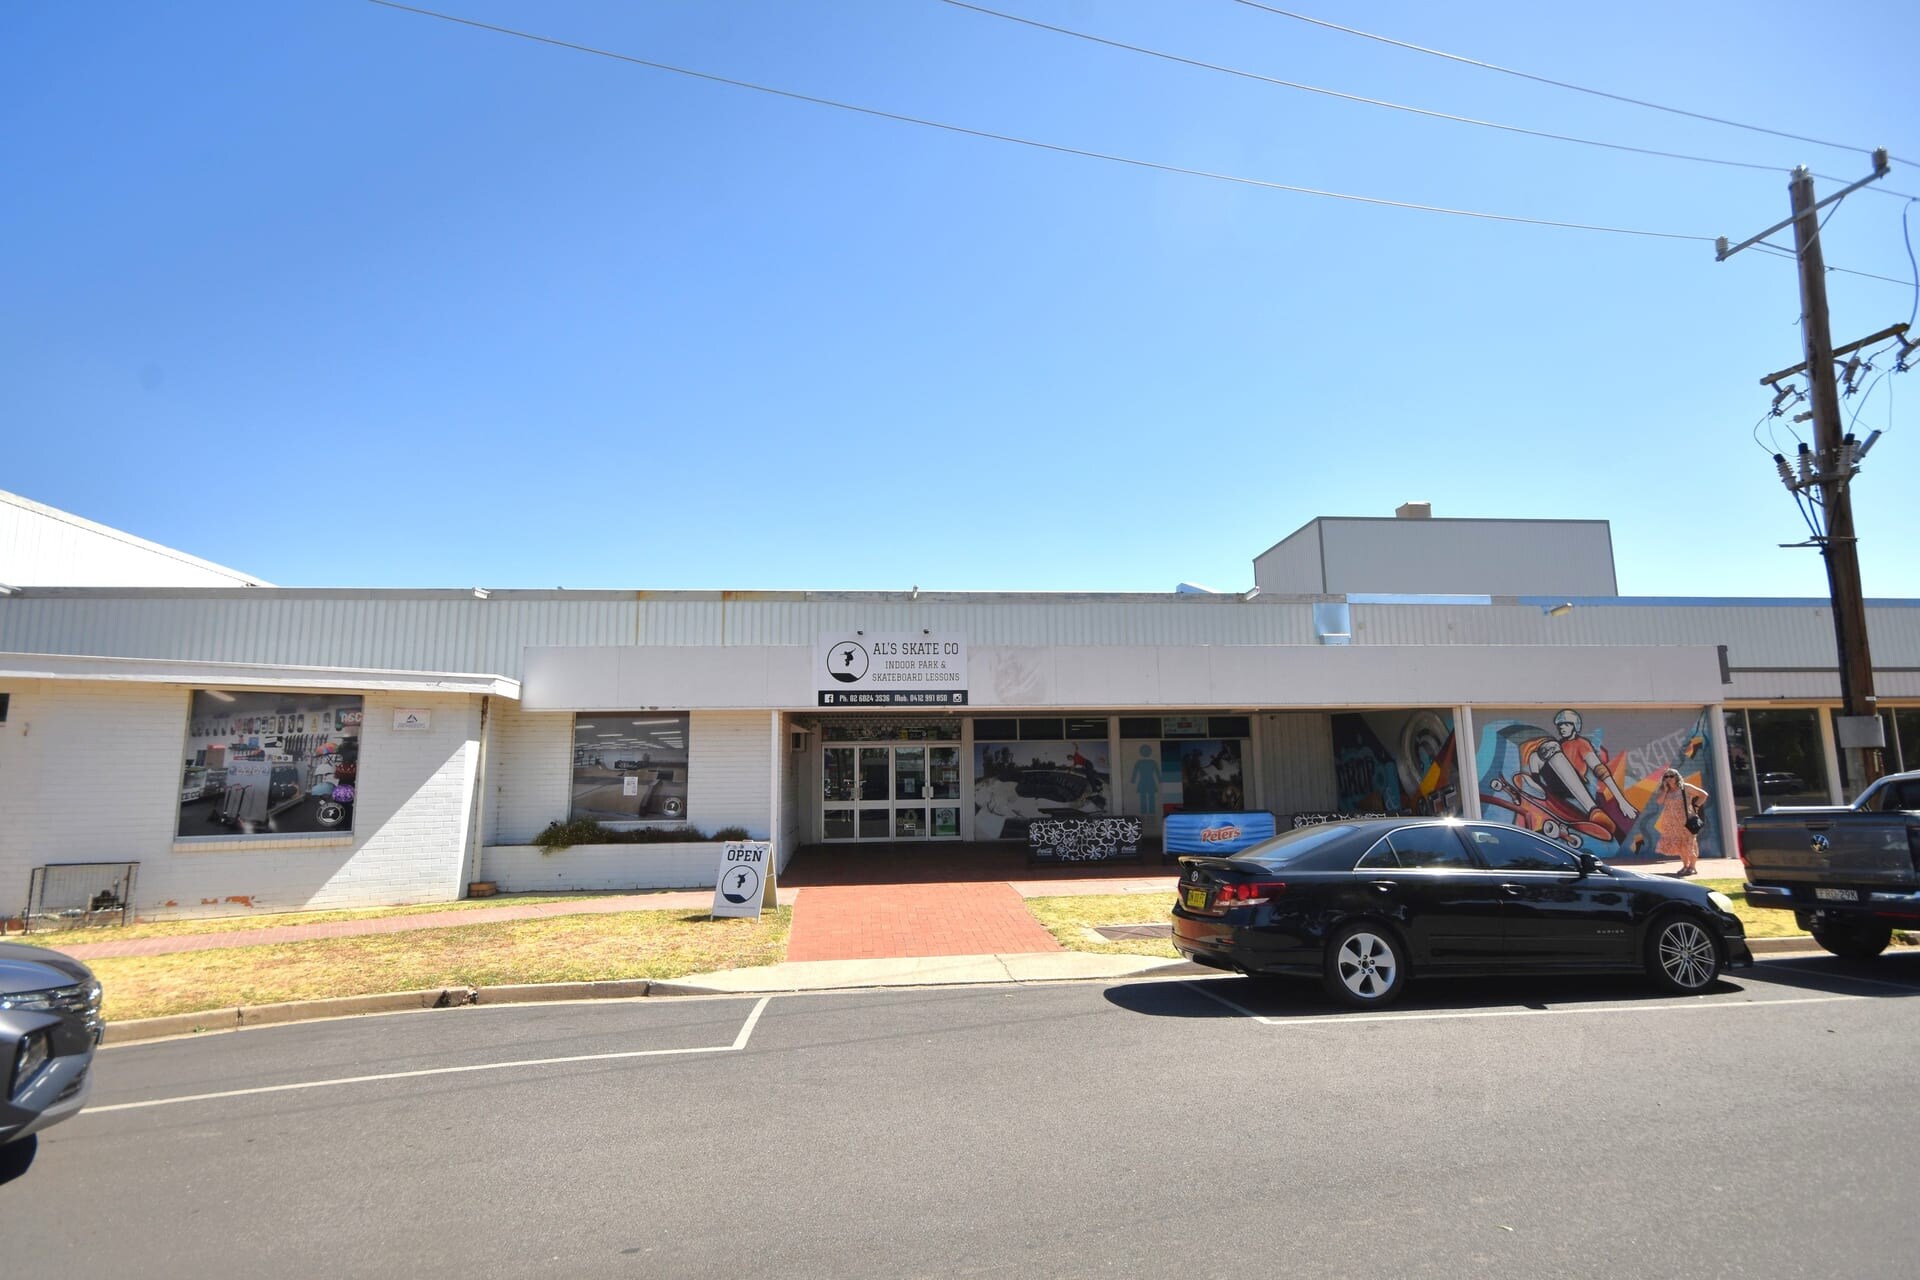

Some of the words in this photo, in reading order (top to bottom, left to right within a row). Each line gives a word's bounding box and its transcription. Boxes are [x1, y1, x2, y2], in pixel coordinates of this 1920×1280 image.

[873, 643, 897, 655] AL'S
[902, 643, 939, 655] SKATE
[944, 643, 959, 655] CO
[885, 661, 915, 669] INDOOR
[918, 661, 938, 669] PARK
[940, 661, 946, 669] &
[872, 673, 923, 682] SKATEBOARD
[925, 673, 960, 681] LESSONS
[1201, 827, 1241, 842] Peters
[727, 849, 762, 862] OPEN
